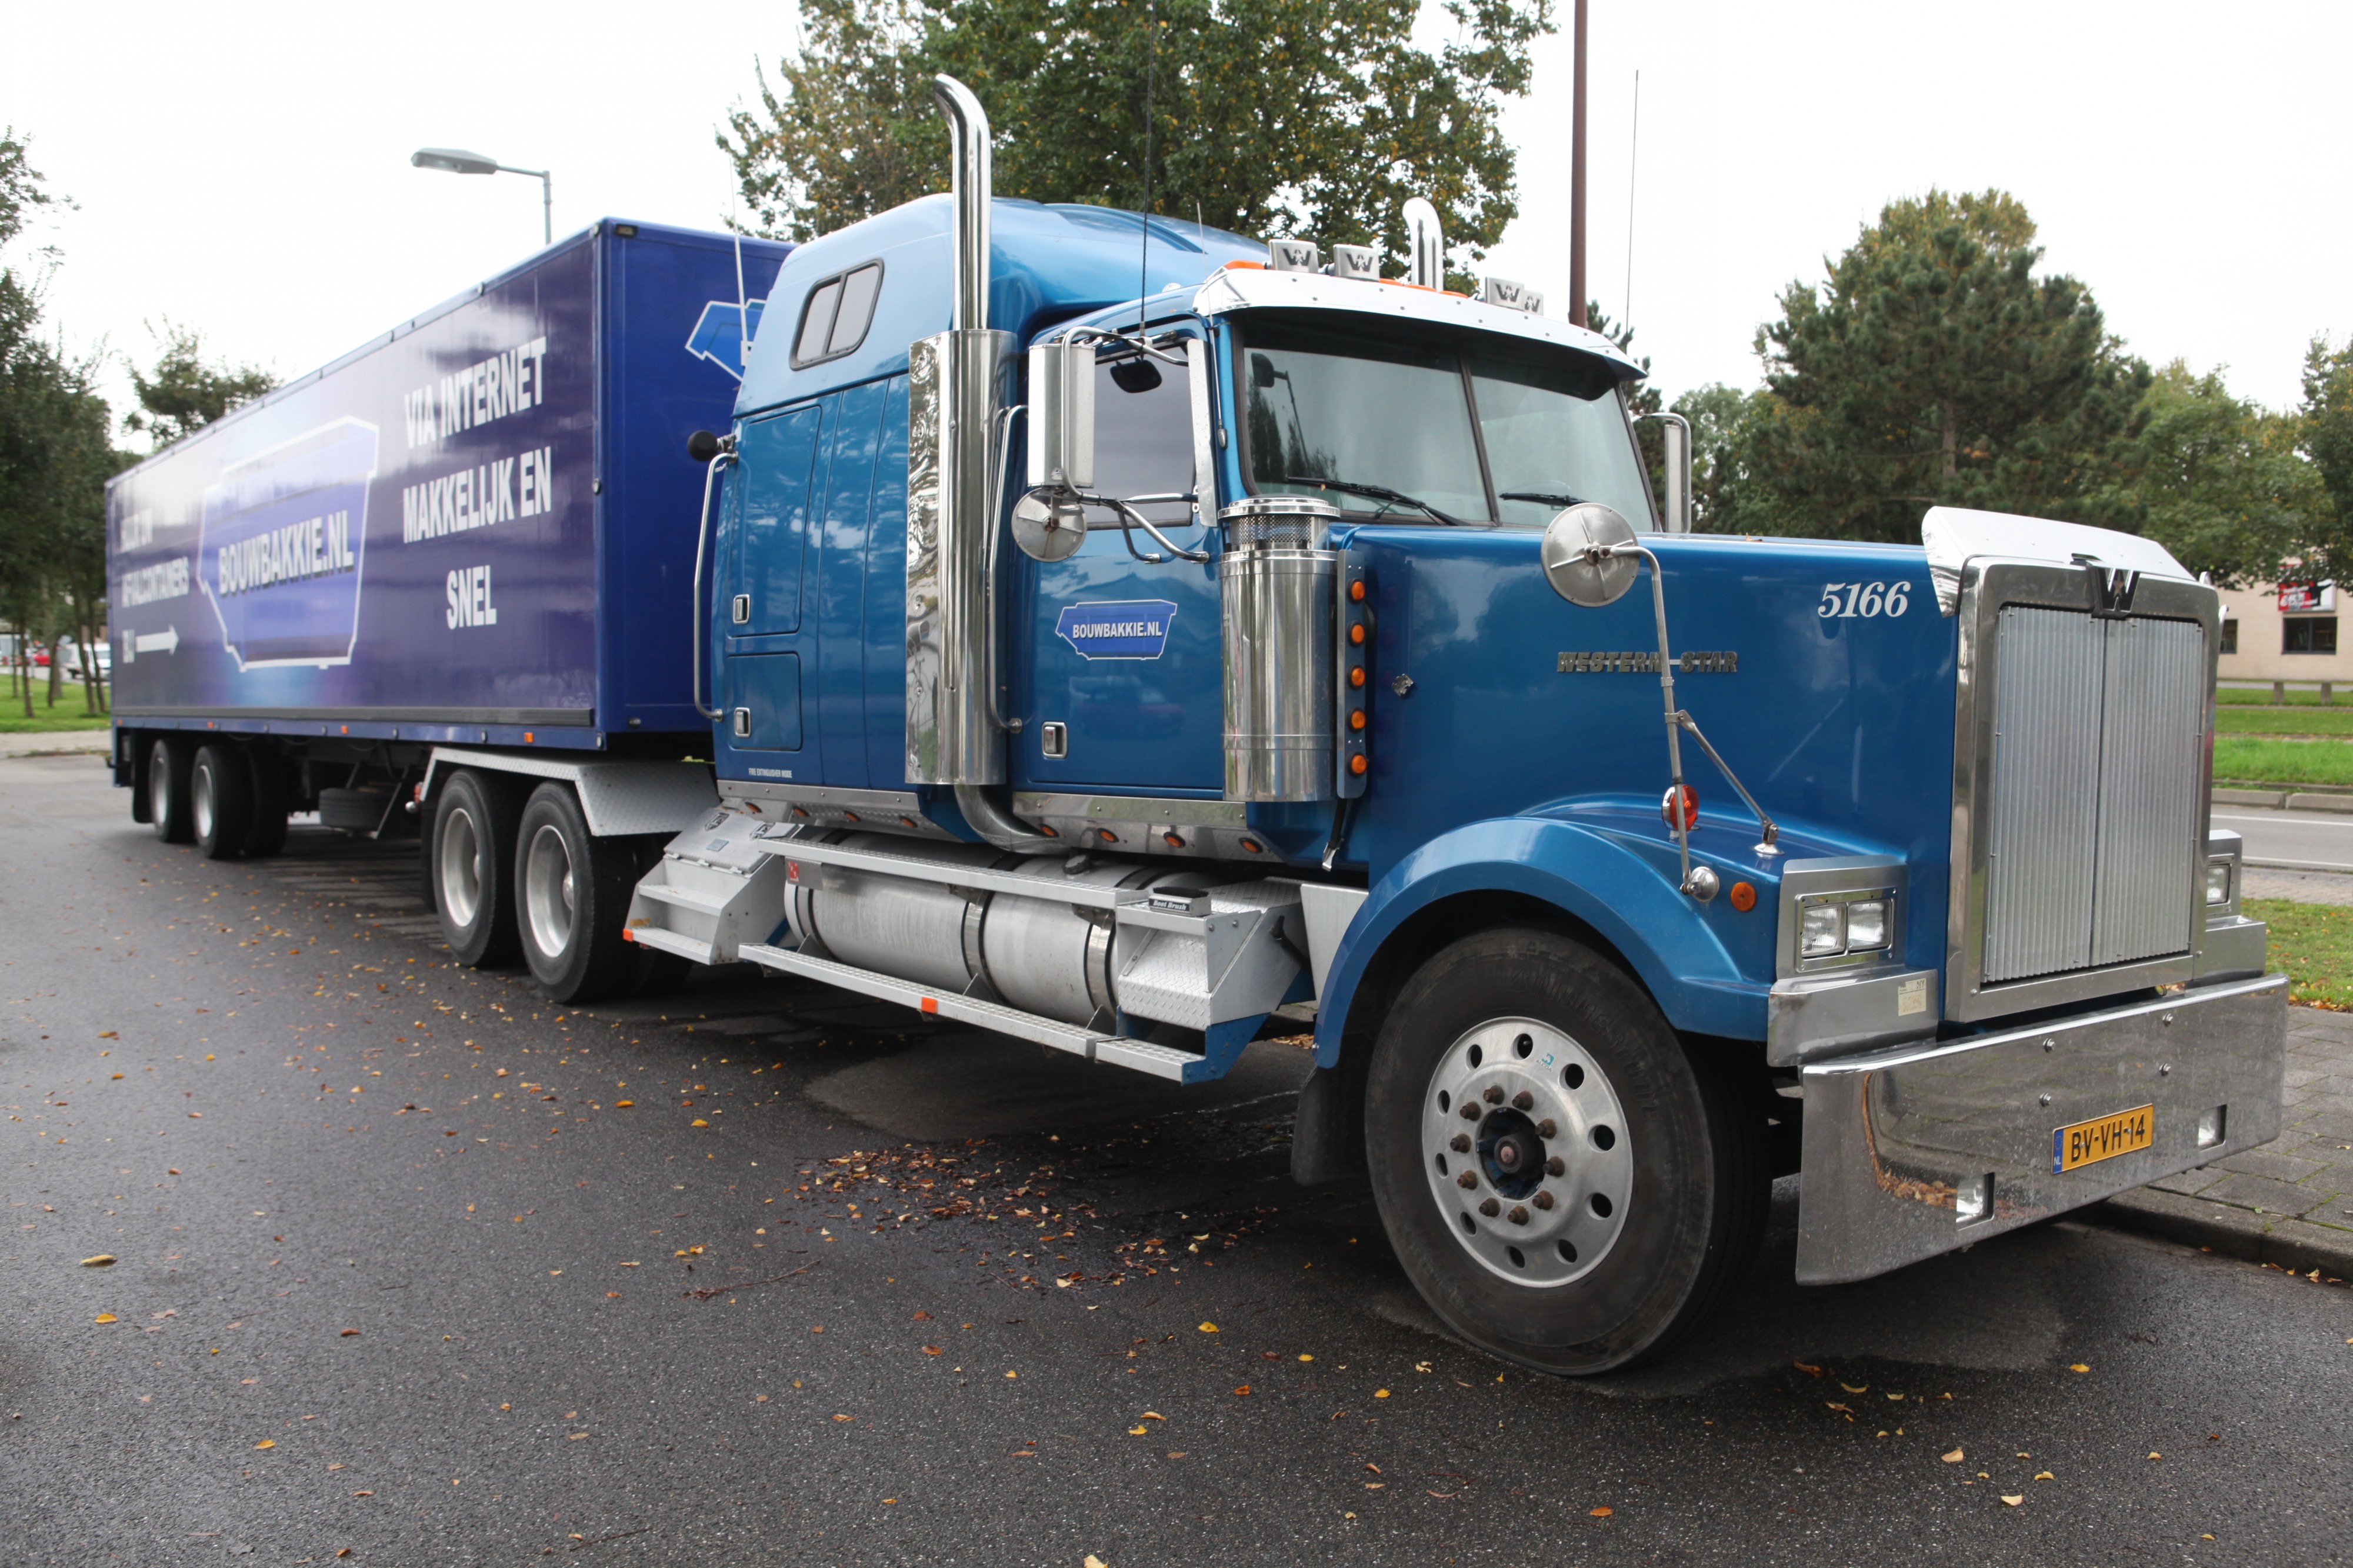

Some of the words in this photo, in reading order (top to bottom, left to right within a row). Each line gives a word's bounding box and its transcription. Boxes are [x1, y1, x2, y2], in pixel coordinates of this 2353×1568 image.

[405, 384, 437, 449] VIA
[441, 336, 546, 438] INTERNET
[403, 456, 515, 544] MAKKELIJK
[520, 446, 551, 518] EN
[218, 509, 354, 596] BOUWBAKKIE.NL
[446, 565, 496, 630] SNEL
[1818, 581, 1911, 618] 5166
[1072, 622, 1162, 639] BOUWBAKKIE.NL
[1557, 651, 1664, 673] WESTERN
[1680, 651, 1738, 673] STAR
[1153, 899, 1167, 908] Boot
[1167, 901, 1187, 910] Brush
[2071, 1113, 2145, 1163] BV-VH-14
[2054, 1156, 2061, 1166] NL
